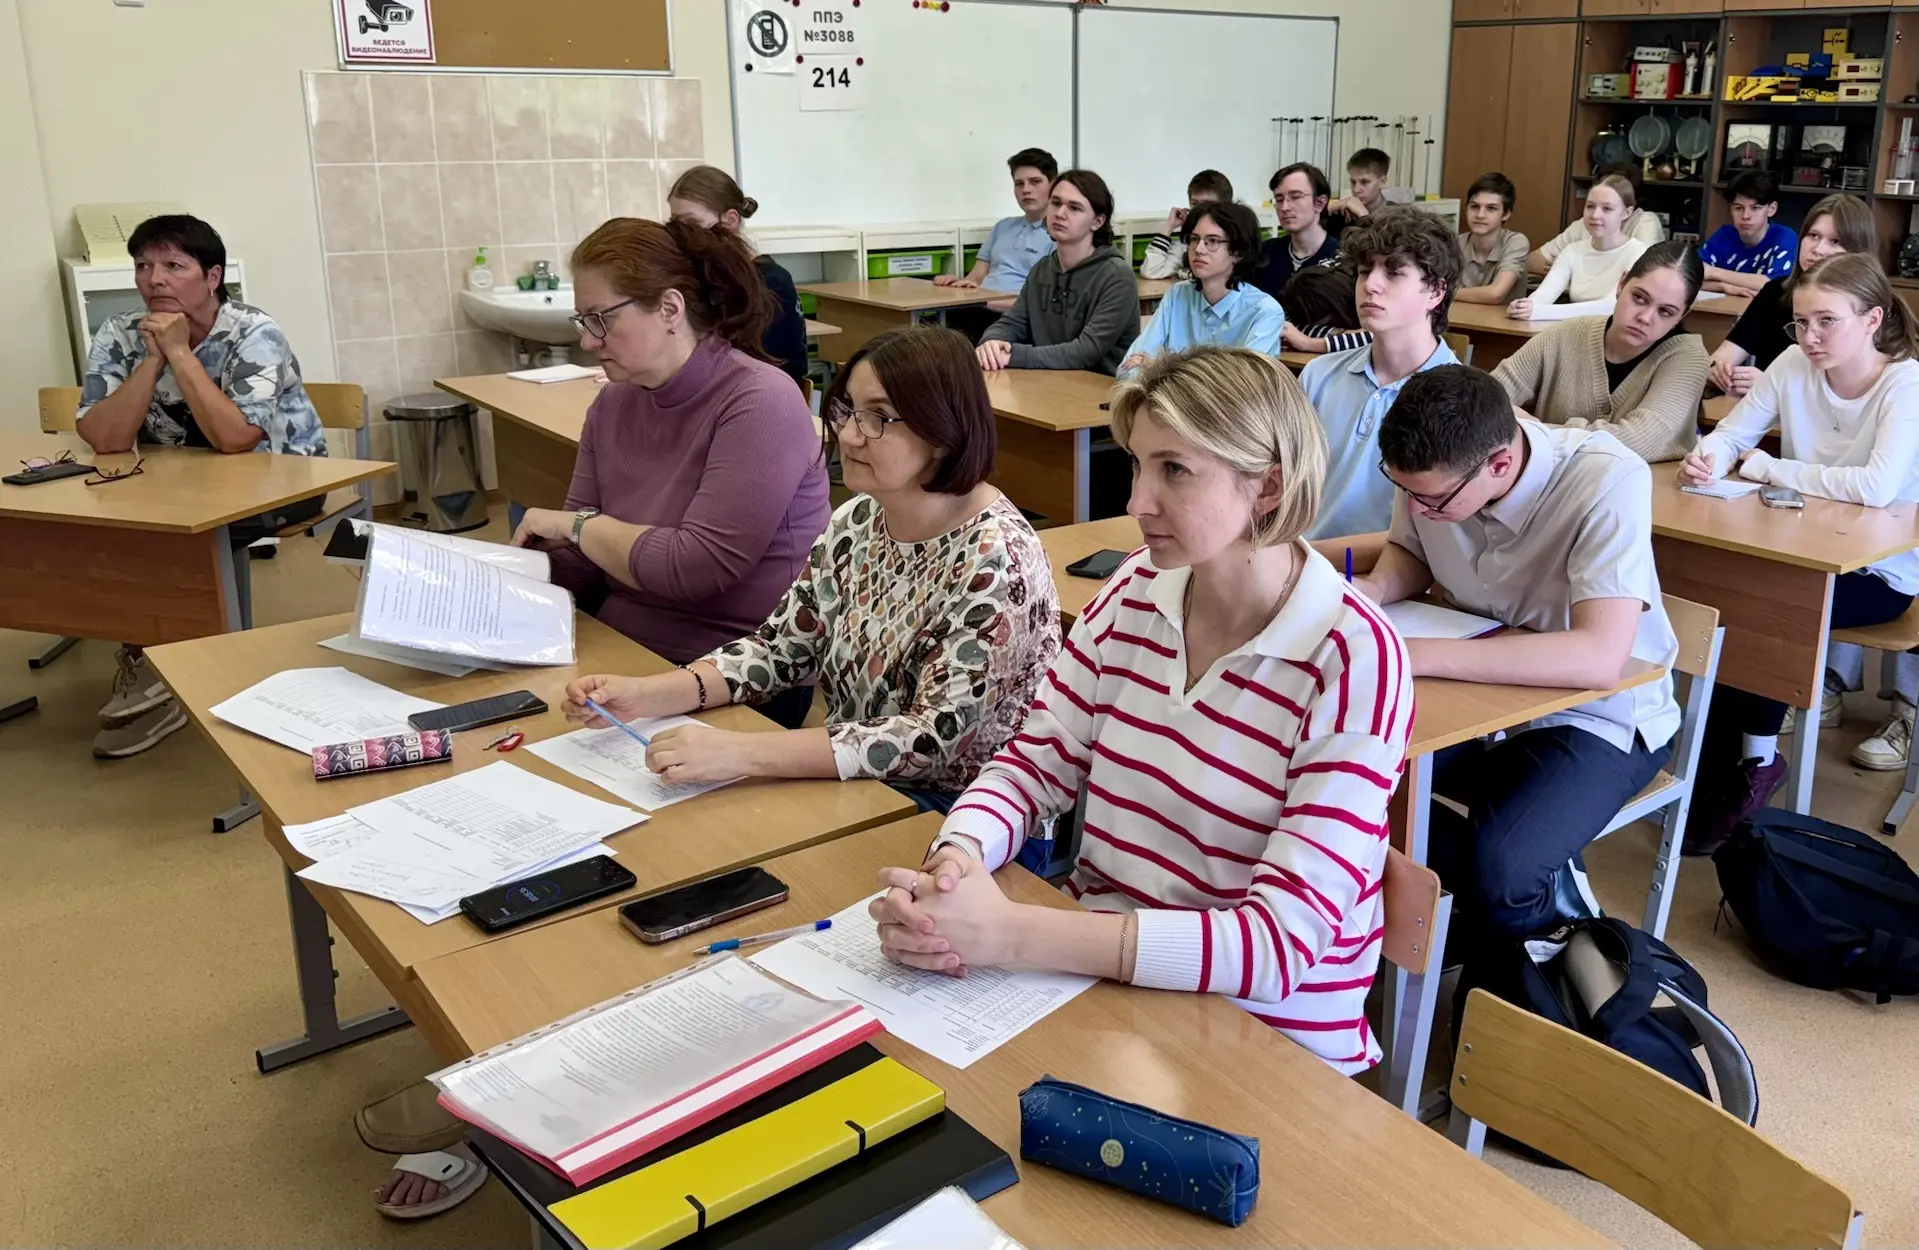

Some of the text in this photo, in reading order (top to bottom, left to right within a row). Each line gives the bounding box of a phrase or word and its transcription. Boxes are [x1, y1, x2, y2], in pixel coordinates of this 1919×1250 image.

[813, 11, 843, 23] ППЭ
[804, 30, 854, 42] №3088
[812, 67, 851, 88] 214
